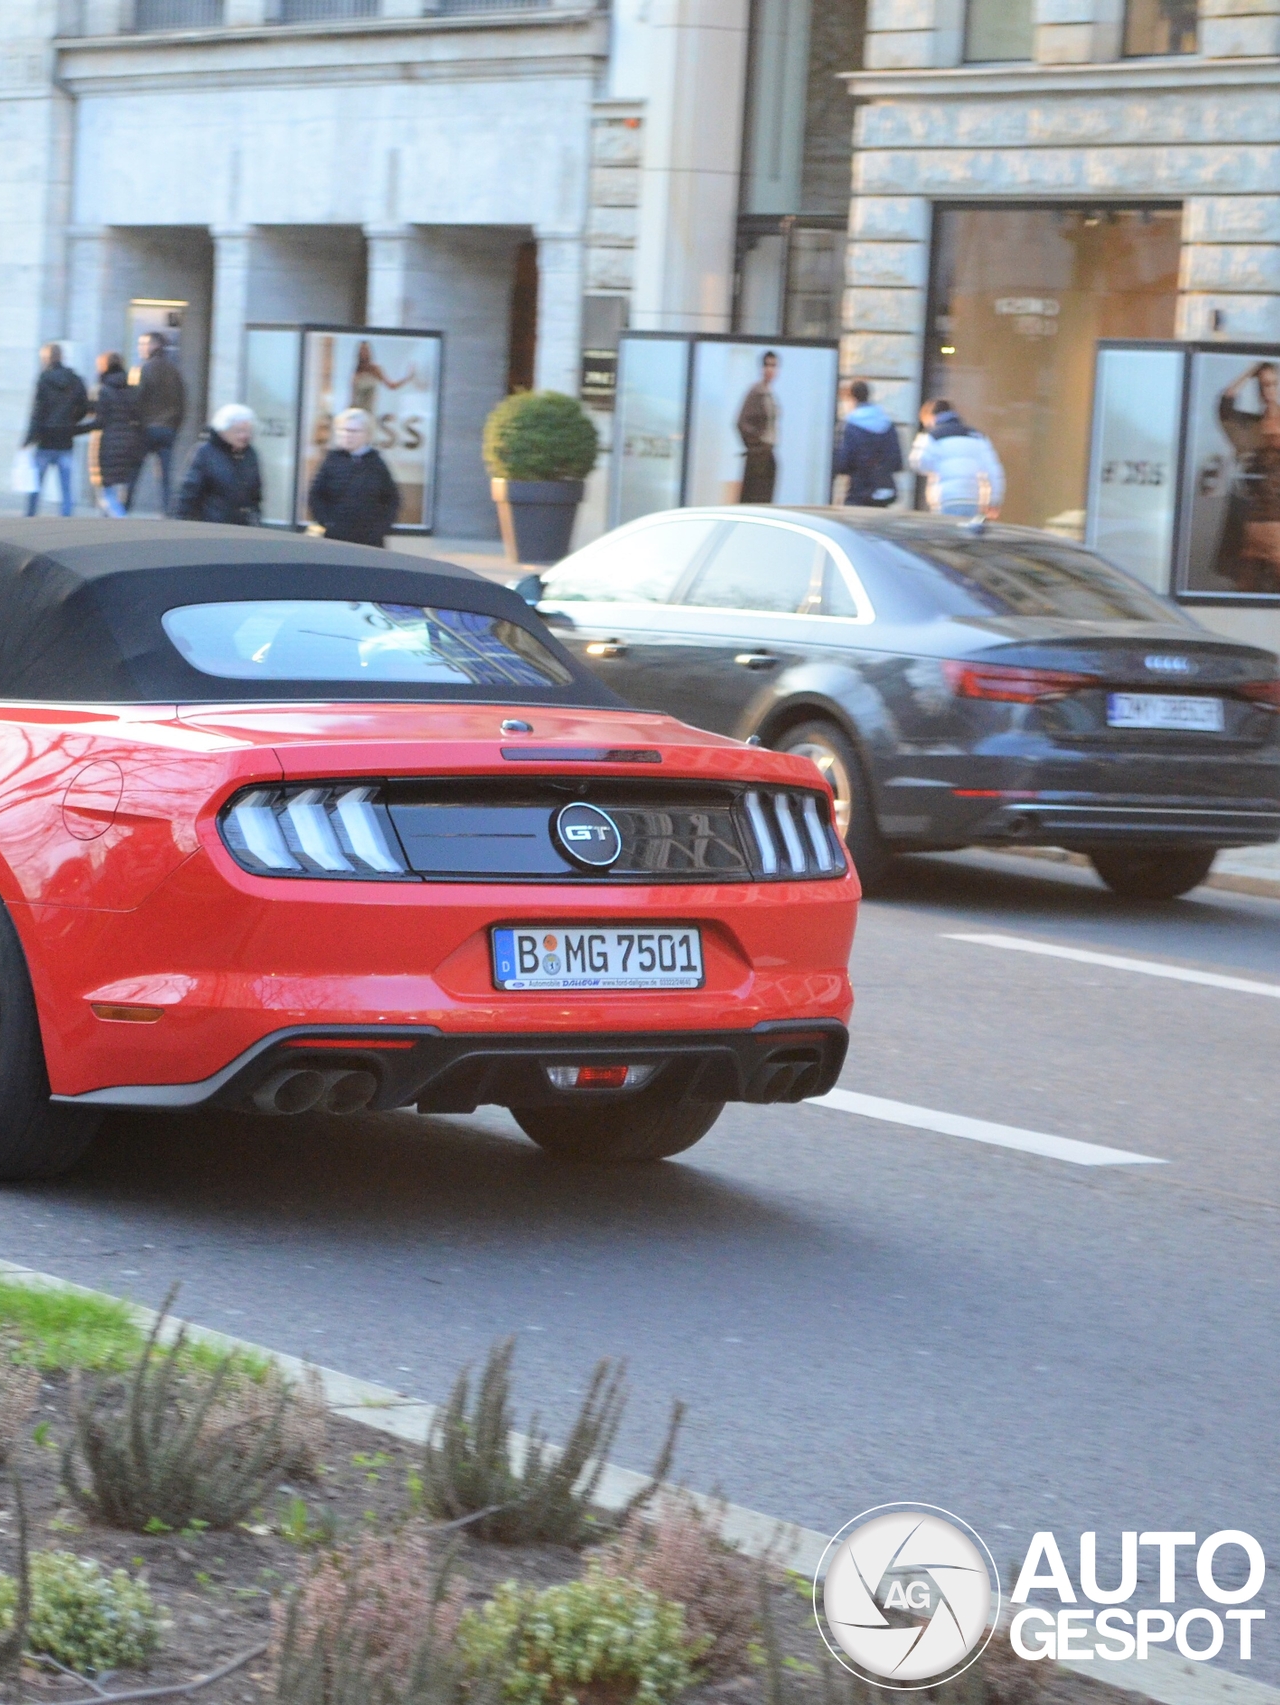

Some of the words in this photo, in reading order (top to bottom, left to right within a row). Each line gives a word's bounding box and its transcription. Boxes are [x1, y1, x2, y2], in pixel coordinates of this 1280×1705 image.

[565, 825, 611, 840] GT
[517, 935, 540, 974] B
[564, 934, 609, 973] MG
[616, 934, 698, 973] 7501
[501, 960, 510, 973] D
[528, 980, 561, 988] Automobile
[602, 979, 657, 988] www.ford-dallgow.de
